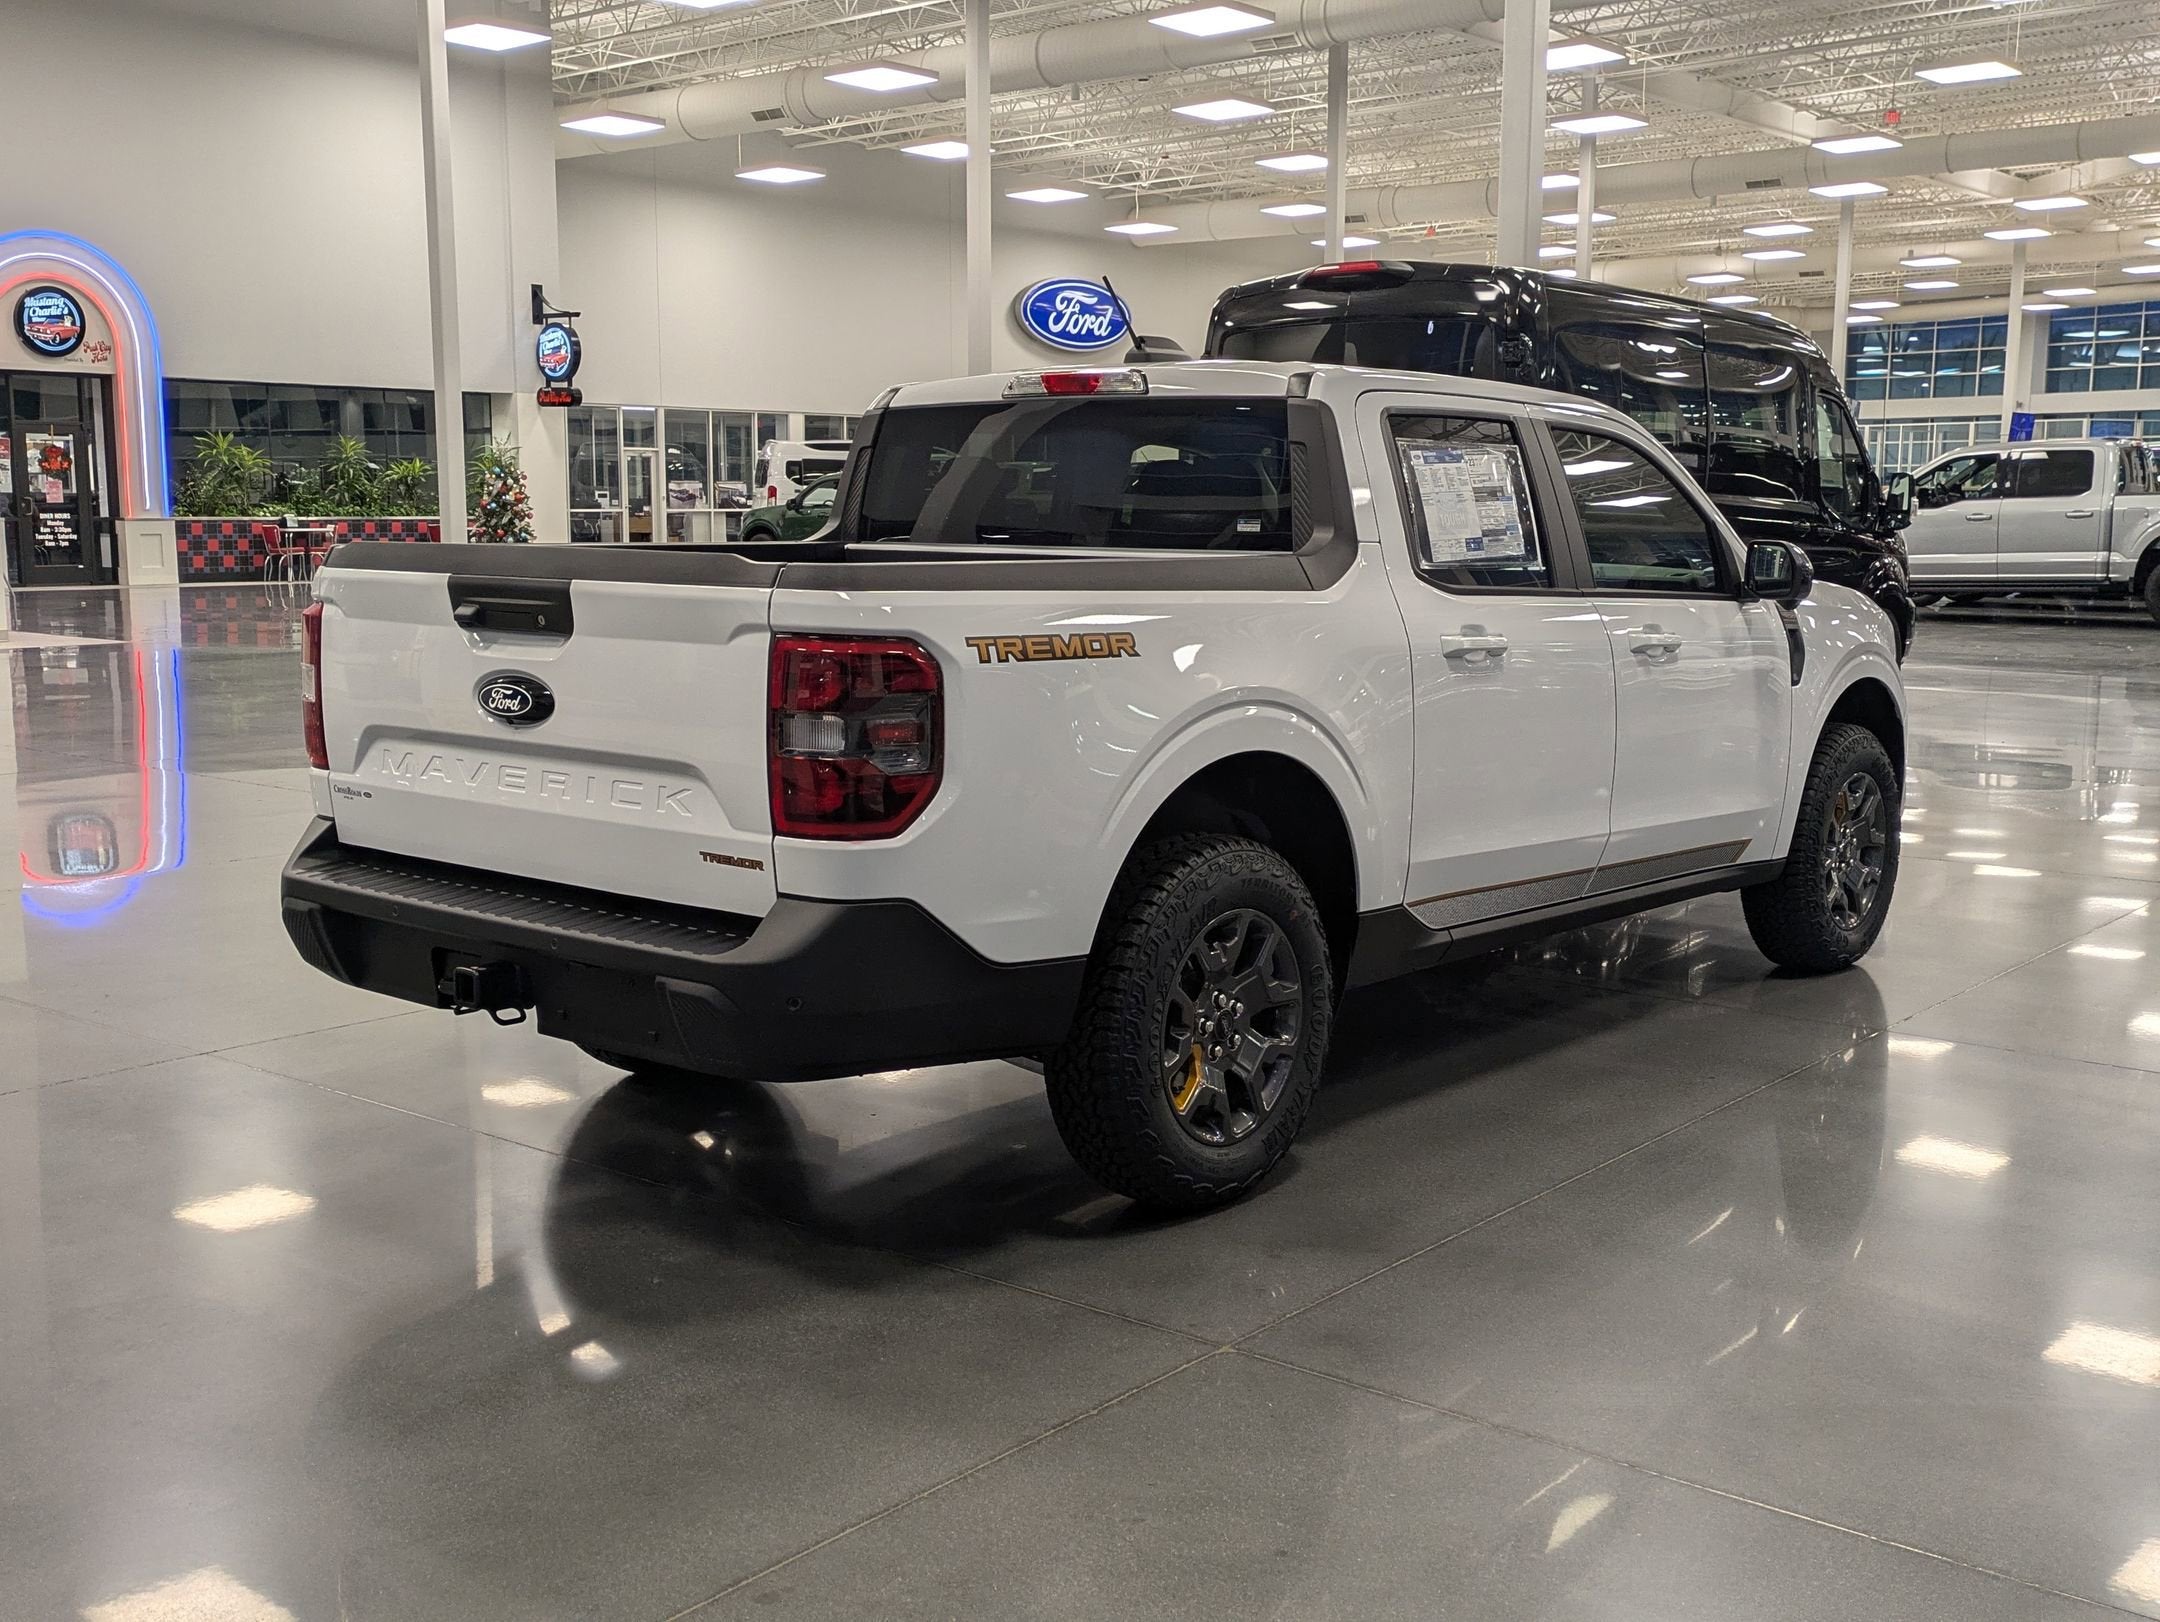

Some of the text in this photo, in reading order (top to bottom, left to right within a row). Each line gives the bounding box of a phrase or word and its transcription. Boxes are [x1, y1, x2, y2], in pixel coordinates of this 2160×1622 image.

[24, 297, 66, 309] Mustang
[29, 305, 69, 317] Charlie's
[1048, 290, 1113, 337] Ford
[965, 632, 1141, 664] TREMOR
[489, 687, 522, 711] Ford
[380, 748, 693, 817] MAVERICK
[699, 850, 765, 872] TREMOR
